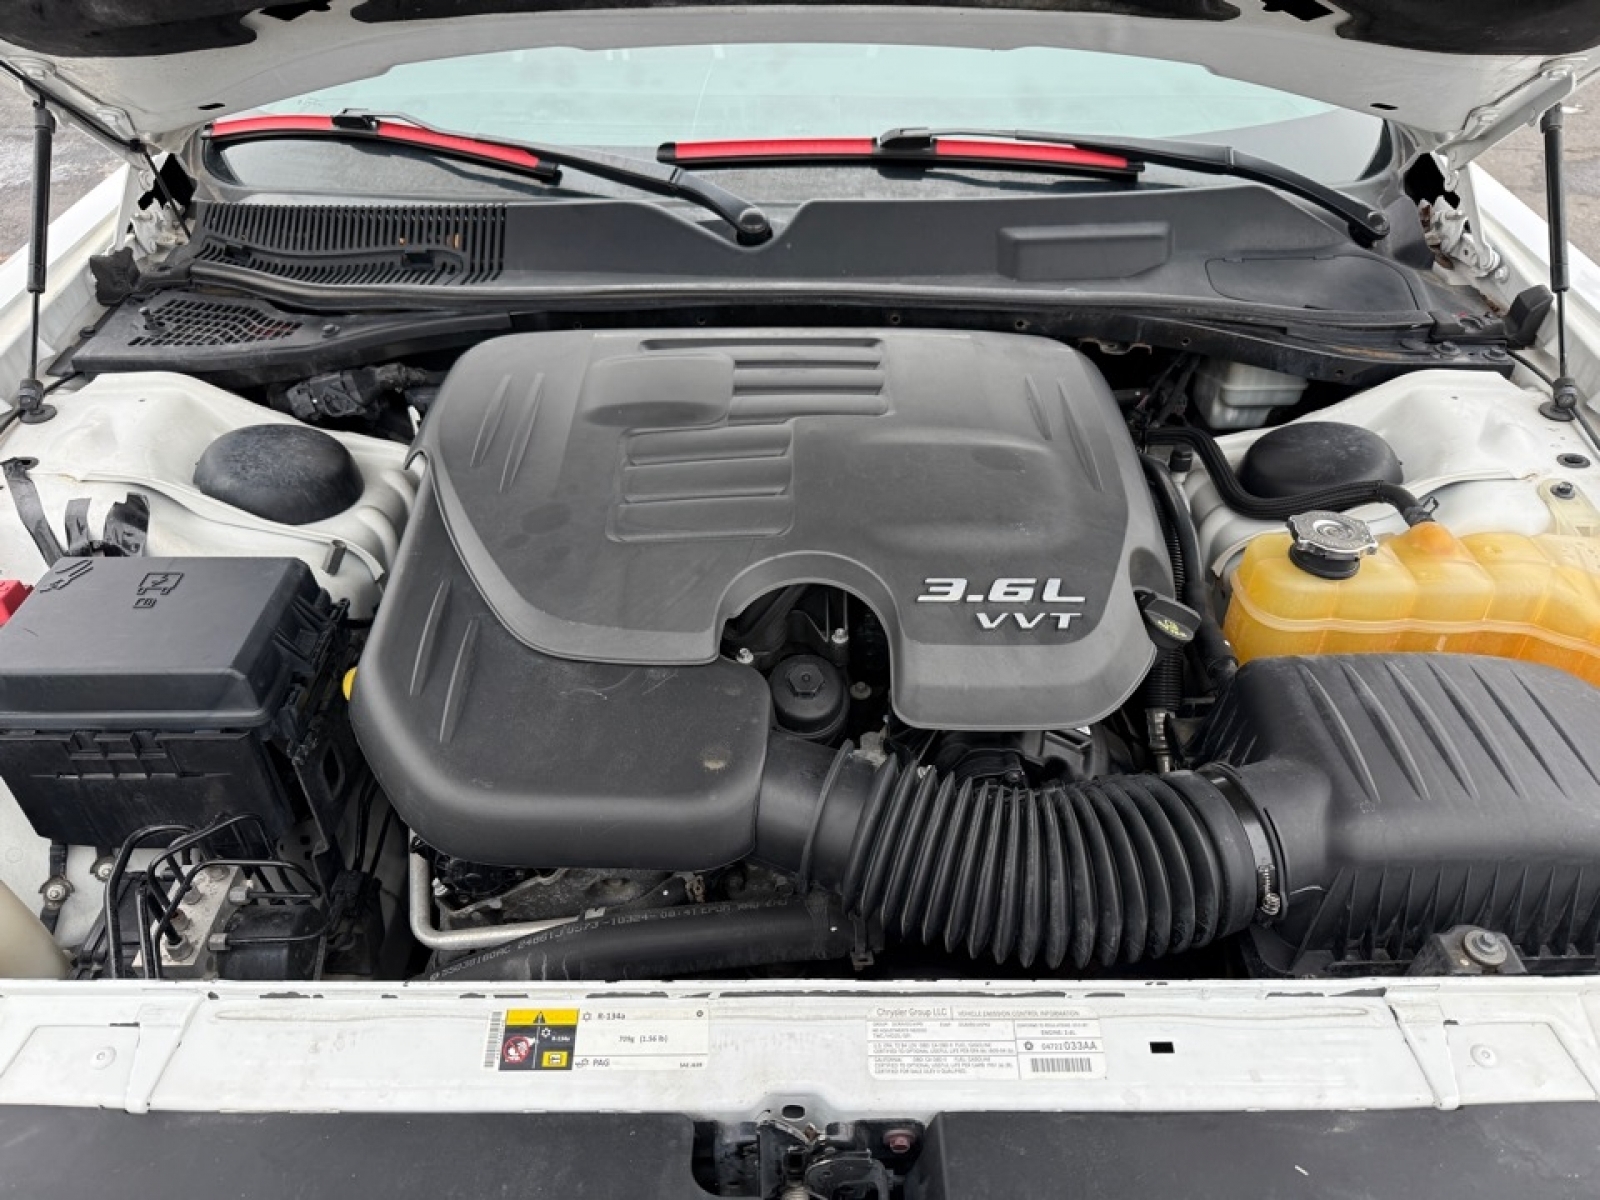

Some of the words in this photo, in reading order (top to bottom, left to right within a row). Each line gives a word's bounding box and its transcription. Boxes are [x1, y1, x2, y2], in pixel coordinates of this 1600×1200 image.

[916, 577, 1086, 603] 3.6L
[975, 612, 1082, 630] VVT
[597, 1012, 626, 1021] R-134a
[876, 1008, 908, 1018] Chrysler
[910, 1008, 932, 1018] Group
[933, 1007, 948, 1016] LLC
[593, 1058, 611, 1067] PAG
